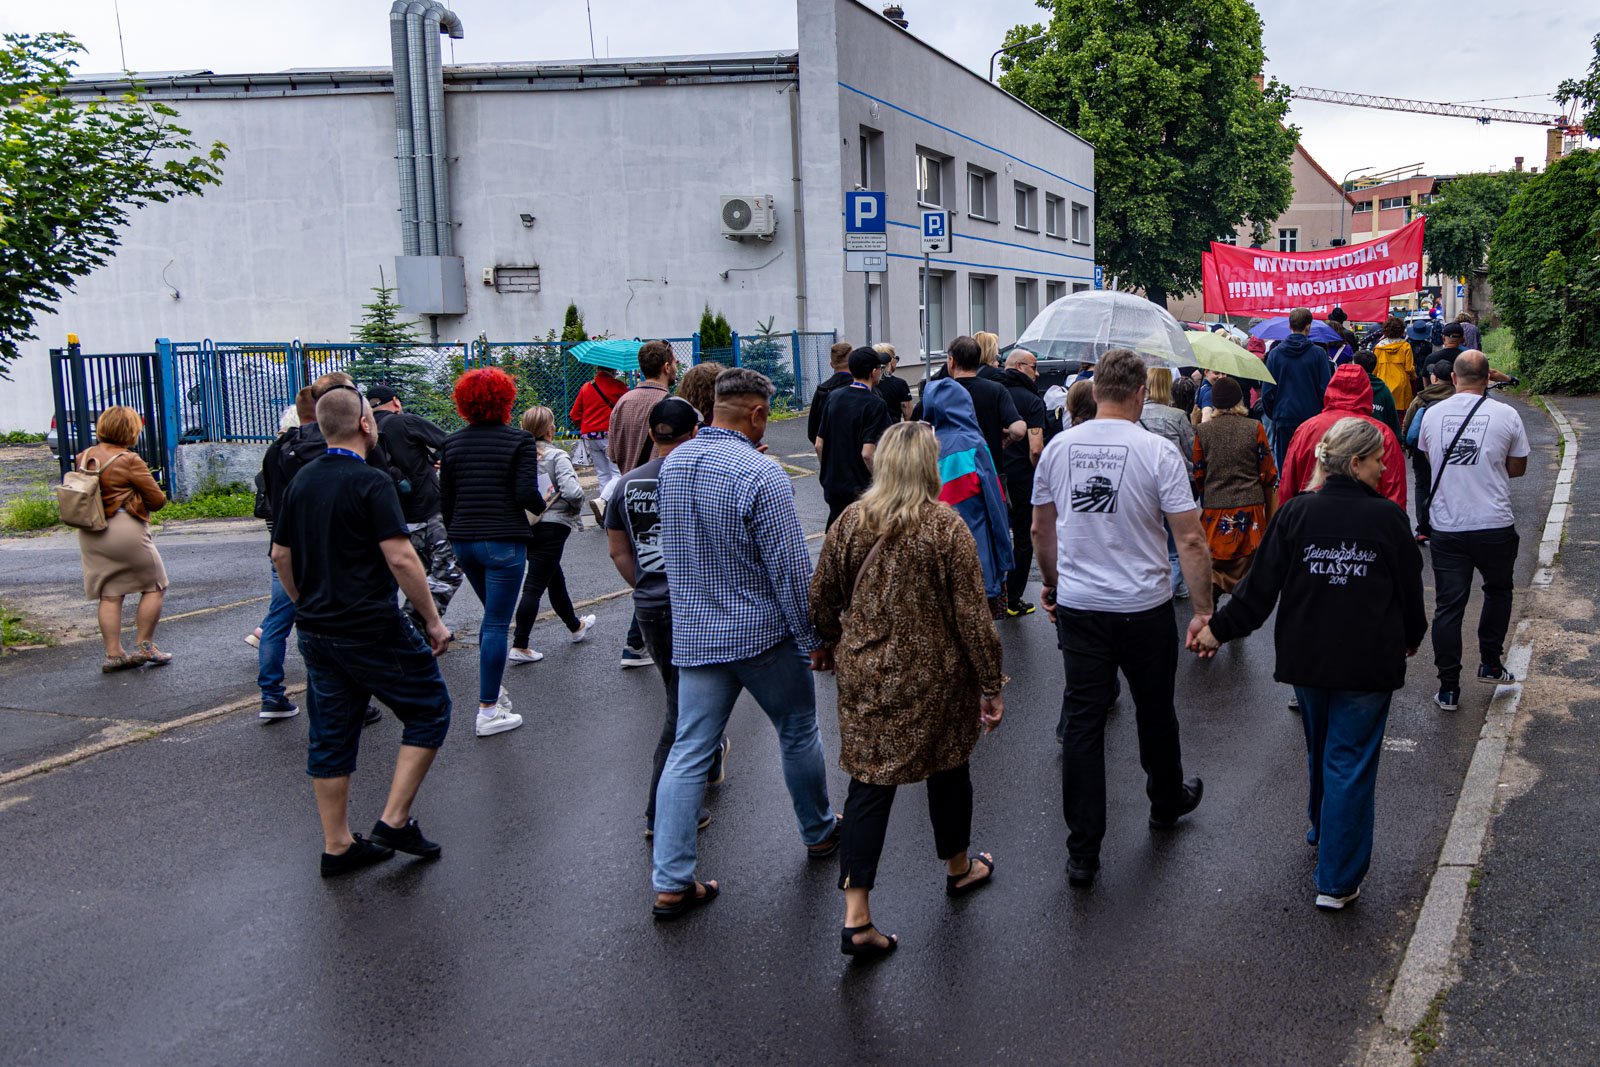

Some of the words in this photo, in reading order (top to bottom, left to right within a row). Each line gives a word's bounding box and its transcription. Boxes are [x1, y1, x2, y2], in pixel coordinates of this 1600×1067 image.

[855, 196, 878, 228] P
[928, 215, 941, 234] P
[1310, 562, 1368, 577] KLASYKI
[1329, 575, 1348, 585] 2016
